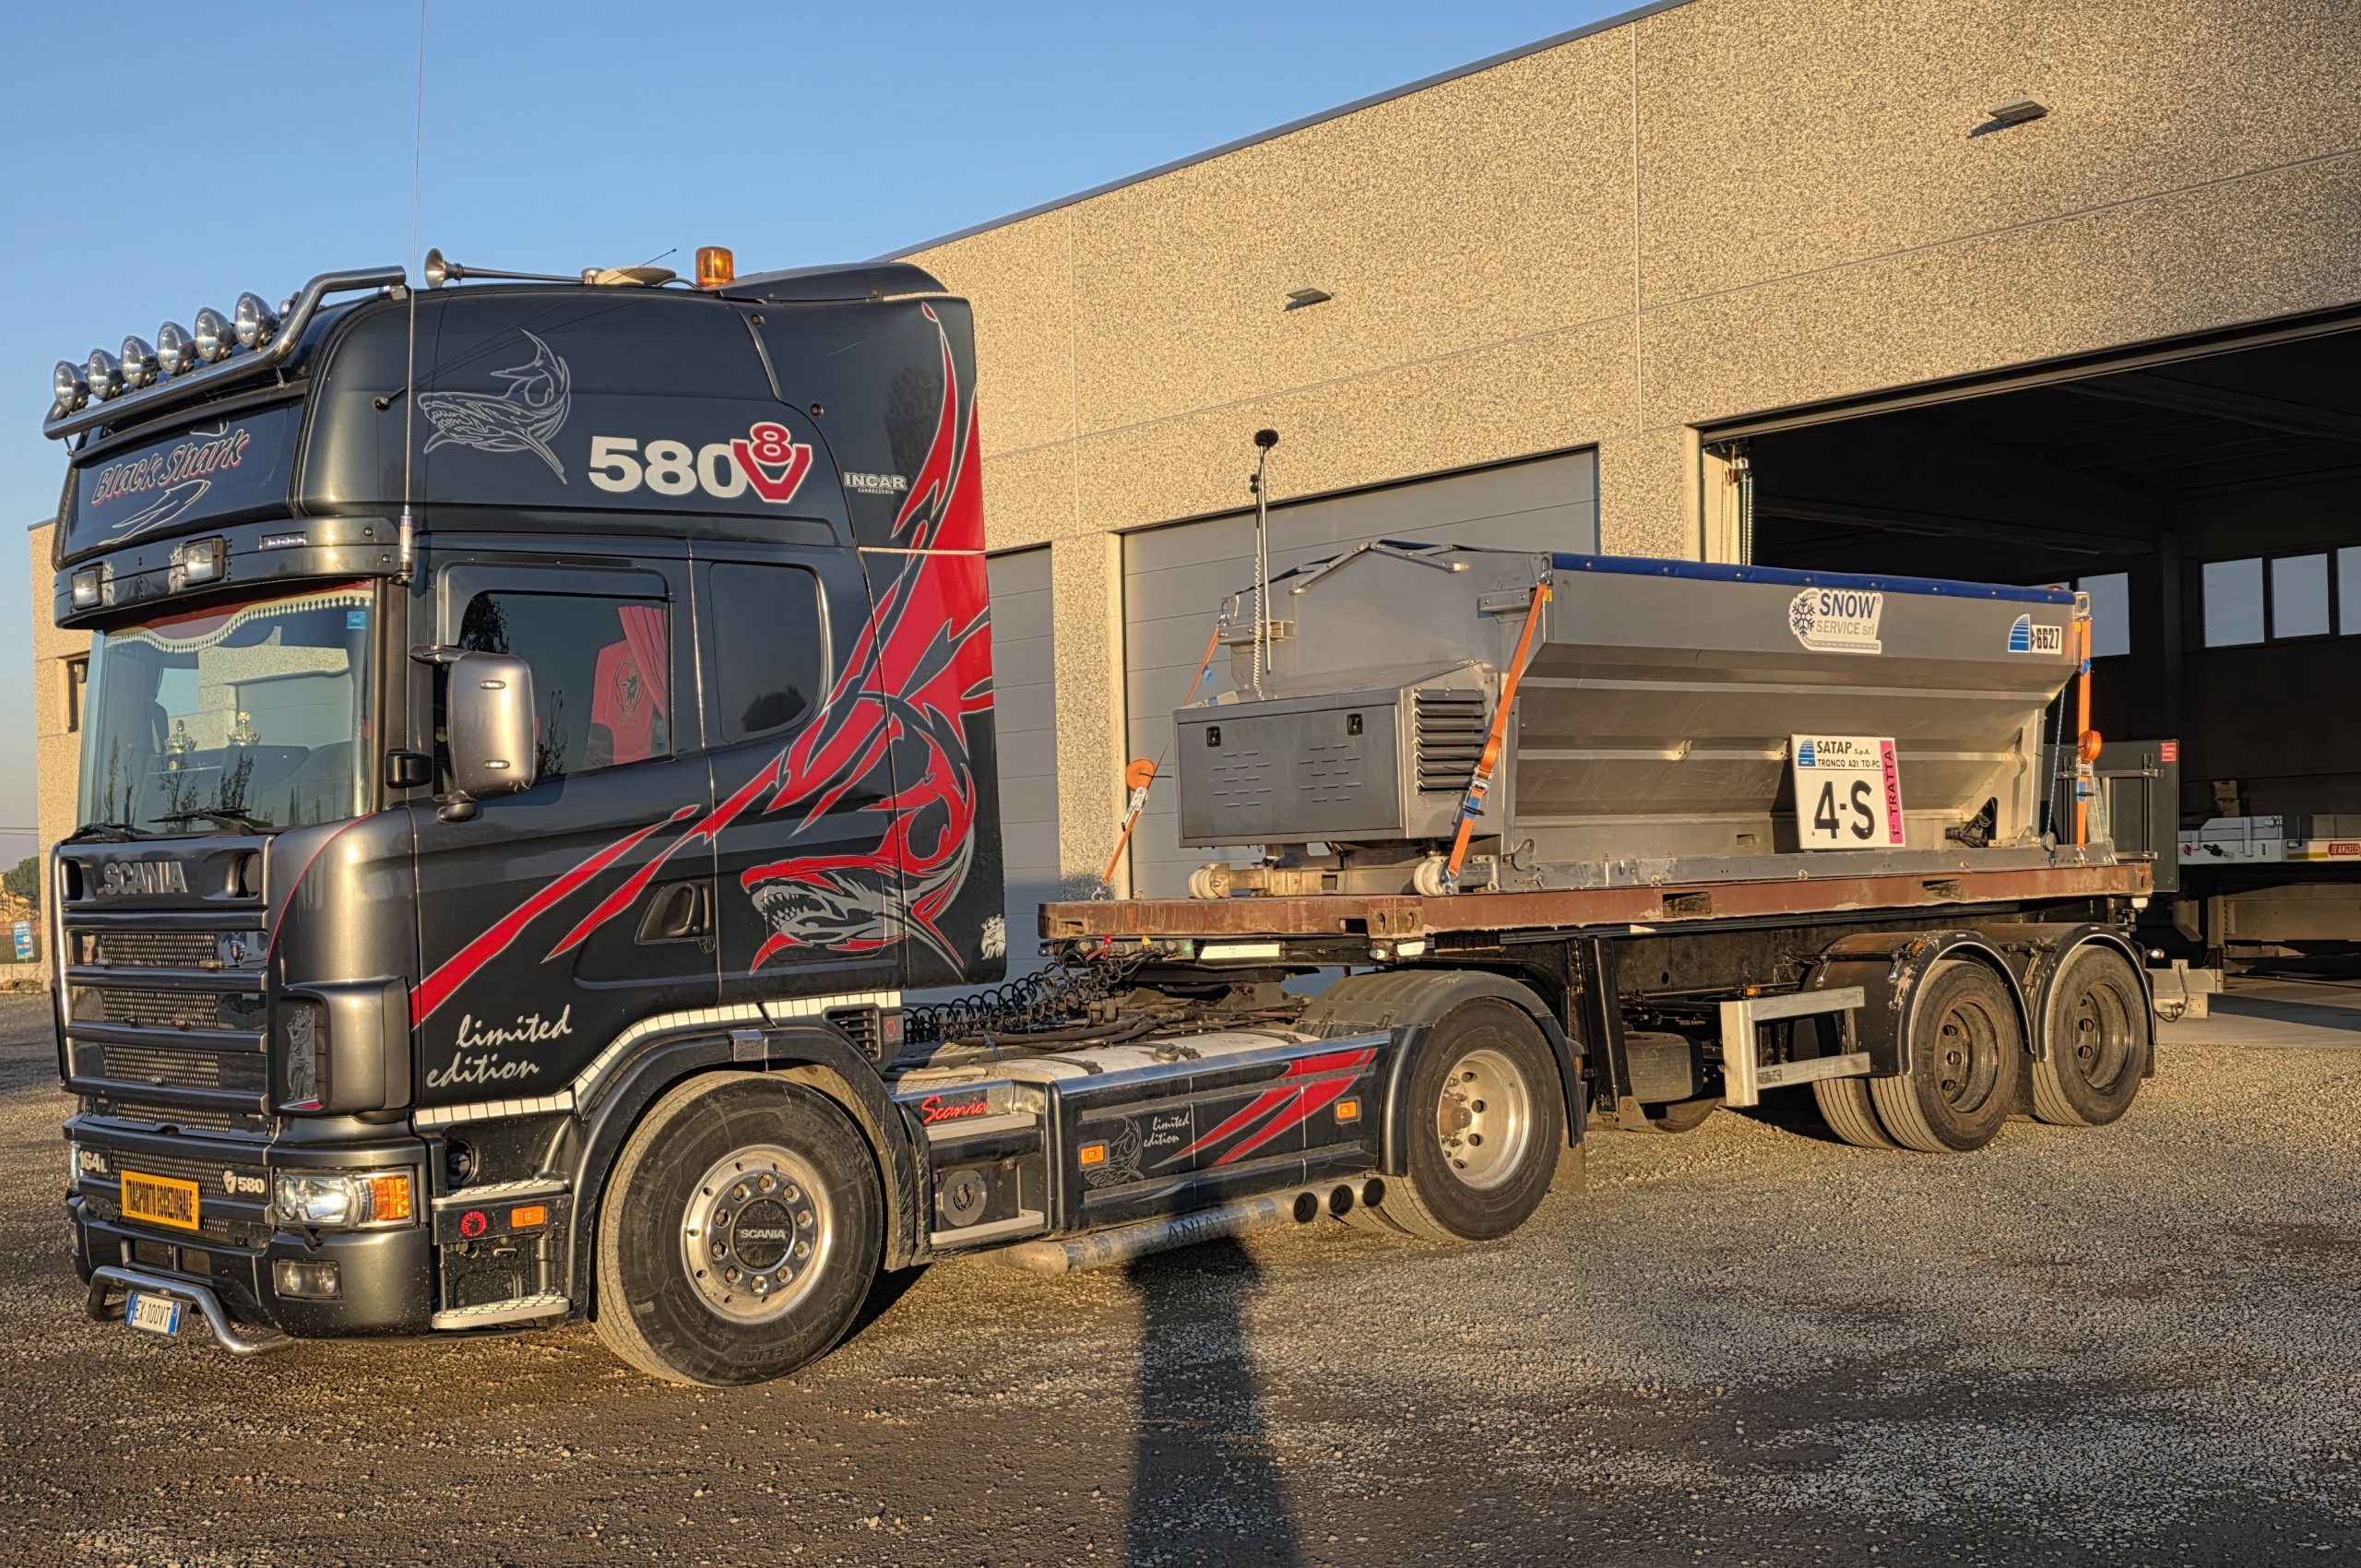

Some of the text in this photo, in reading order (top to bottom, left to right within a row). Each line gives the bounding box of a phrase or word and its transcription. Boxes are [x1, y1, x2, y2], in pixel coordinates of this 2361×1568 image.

[90, 428, 251, 506] Black Shark
[587, 435, 748, 499] 580
[844, 471, 908, 491] INCAR
[1819, 592, 1876, 619] SNOW
[1816, 619, 1875, 636] SERVICE srl
[2036, 627, 2060, 649] 6627
[1817, 741, 1853, 754] SATAP
[1817, 758, 1845, 767] TRONCO
[1848, 759, 1859, 768] A21
[1862, 760, 1880, 768] TO-PC
[1883, 750, 1899, 816] TRATTA
[1813, 779, 1876, 840] 4-S
[103, 861, 188, 896] SCANIA
[456, 1004, 573, 1049] limited
[425, 1051, 540, 1088] edition
[920, 1095, 989, 1125] Scania
[1152, 1111, 1190, 1131] limited
[1144, 1132, 1180, 1147] edition
[125, 1179, 156, 1217] TRASPORTO
[237, 1176, 266, 1194] 580
[741, 1229, 787, 1240] SCANIA
